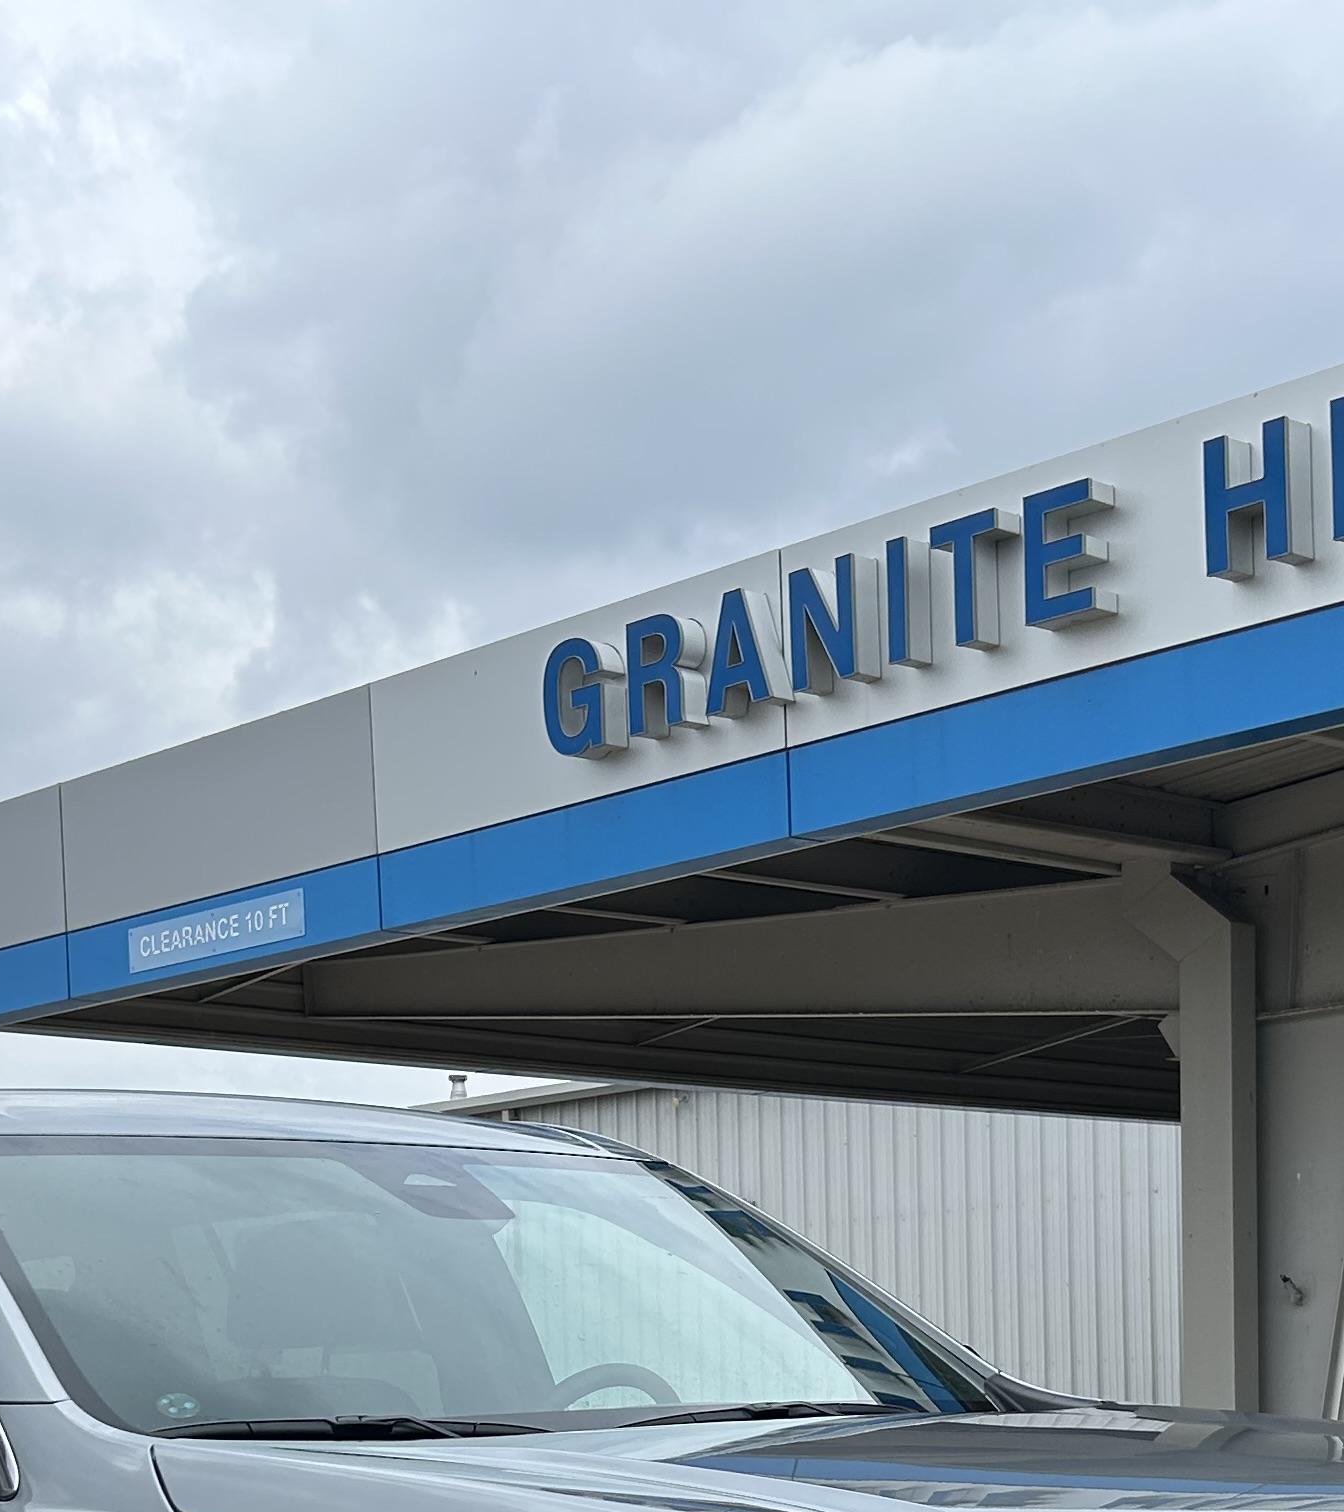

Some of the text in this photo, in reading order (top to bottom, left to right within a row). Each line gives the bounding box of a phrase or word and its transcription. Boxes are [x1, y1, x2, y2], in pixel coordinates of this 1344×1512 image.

[543, 478, 1118, 760] GRANITE
[140, 902, 289, 957] CLEARANCE 10 FT
